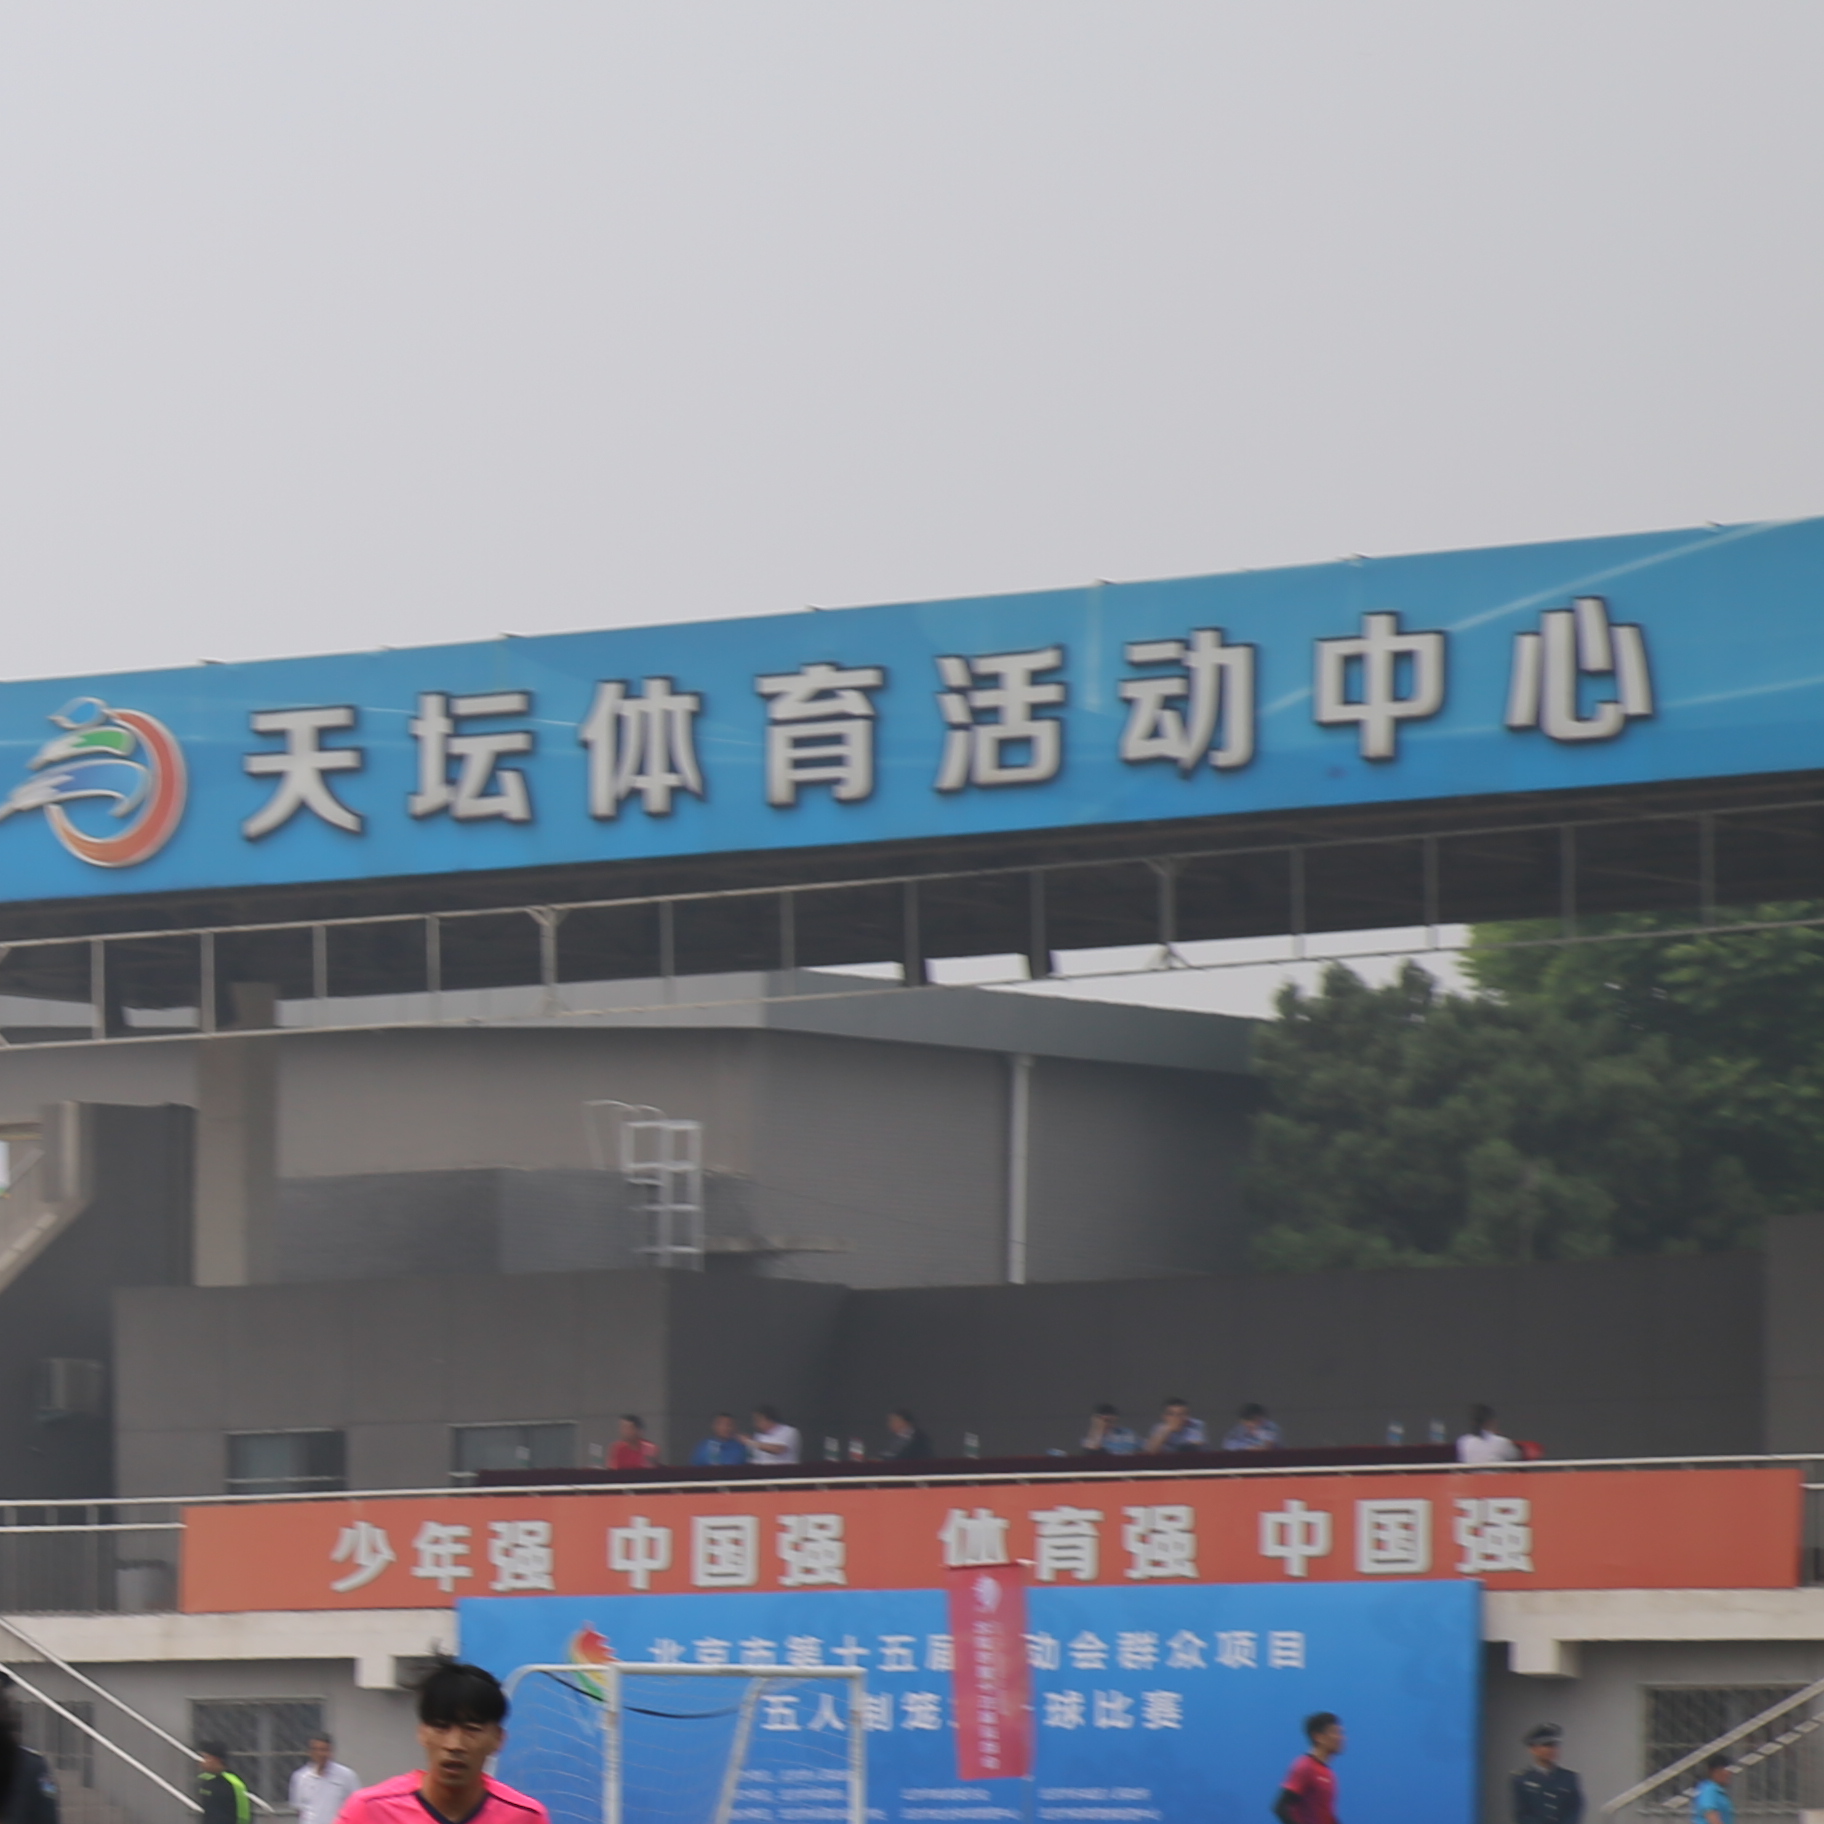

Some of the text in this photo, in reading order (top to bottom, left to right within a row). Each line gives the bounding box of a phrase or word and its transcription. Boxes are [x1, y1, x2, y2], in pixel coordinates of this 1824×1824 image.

[238, 597, 1658, 846] 天坛体育活动中心
[330, 1497, 1535, 1594] 少年强 中国强 体育强 中国强
[648, 1629, 1307, 1671] 北京市第十五届动会群众项目
[761, 1689, 1183, 1732] 五人制笼球比赛
